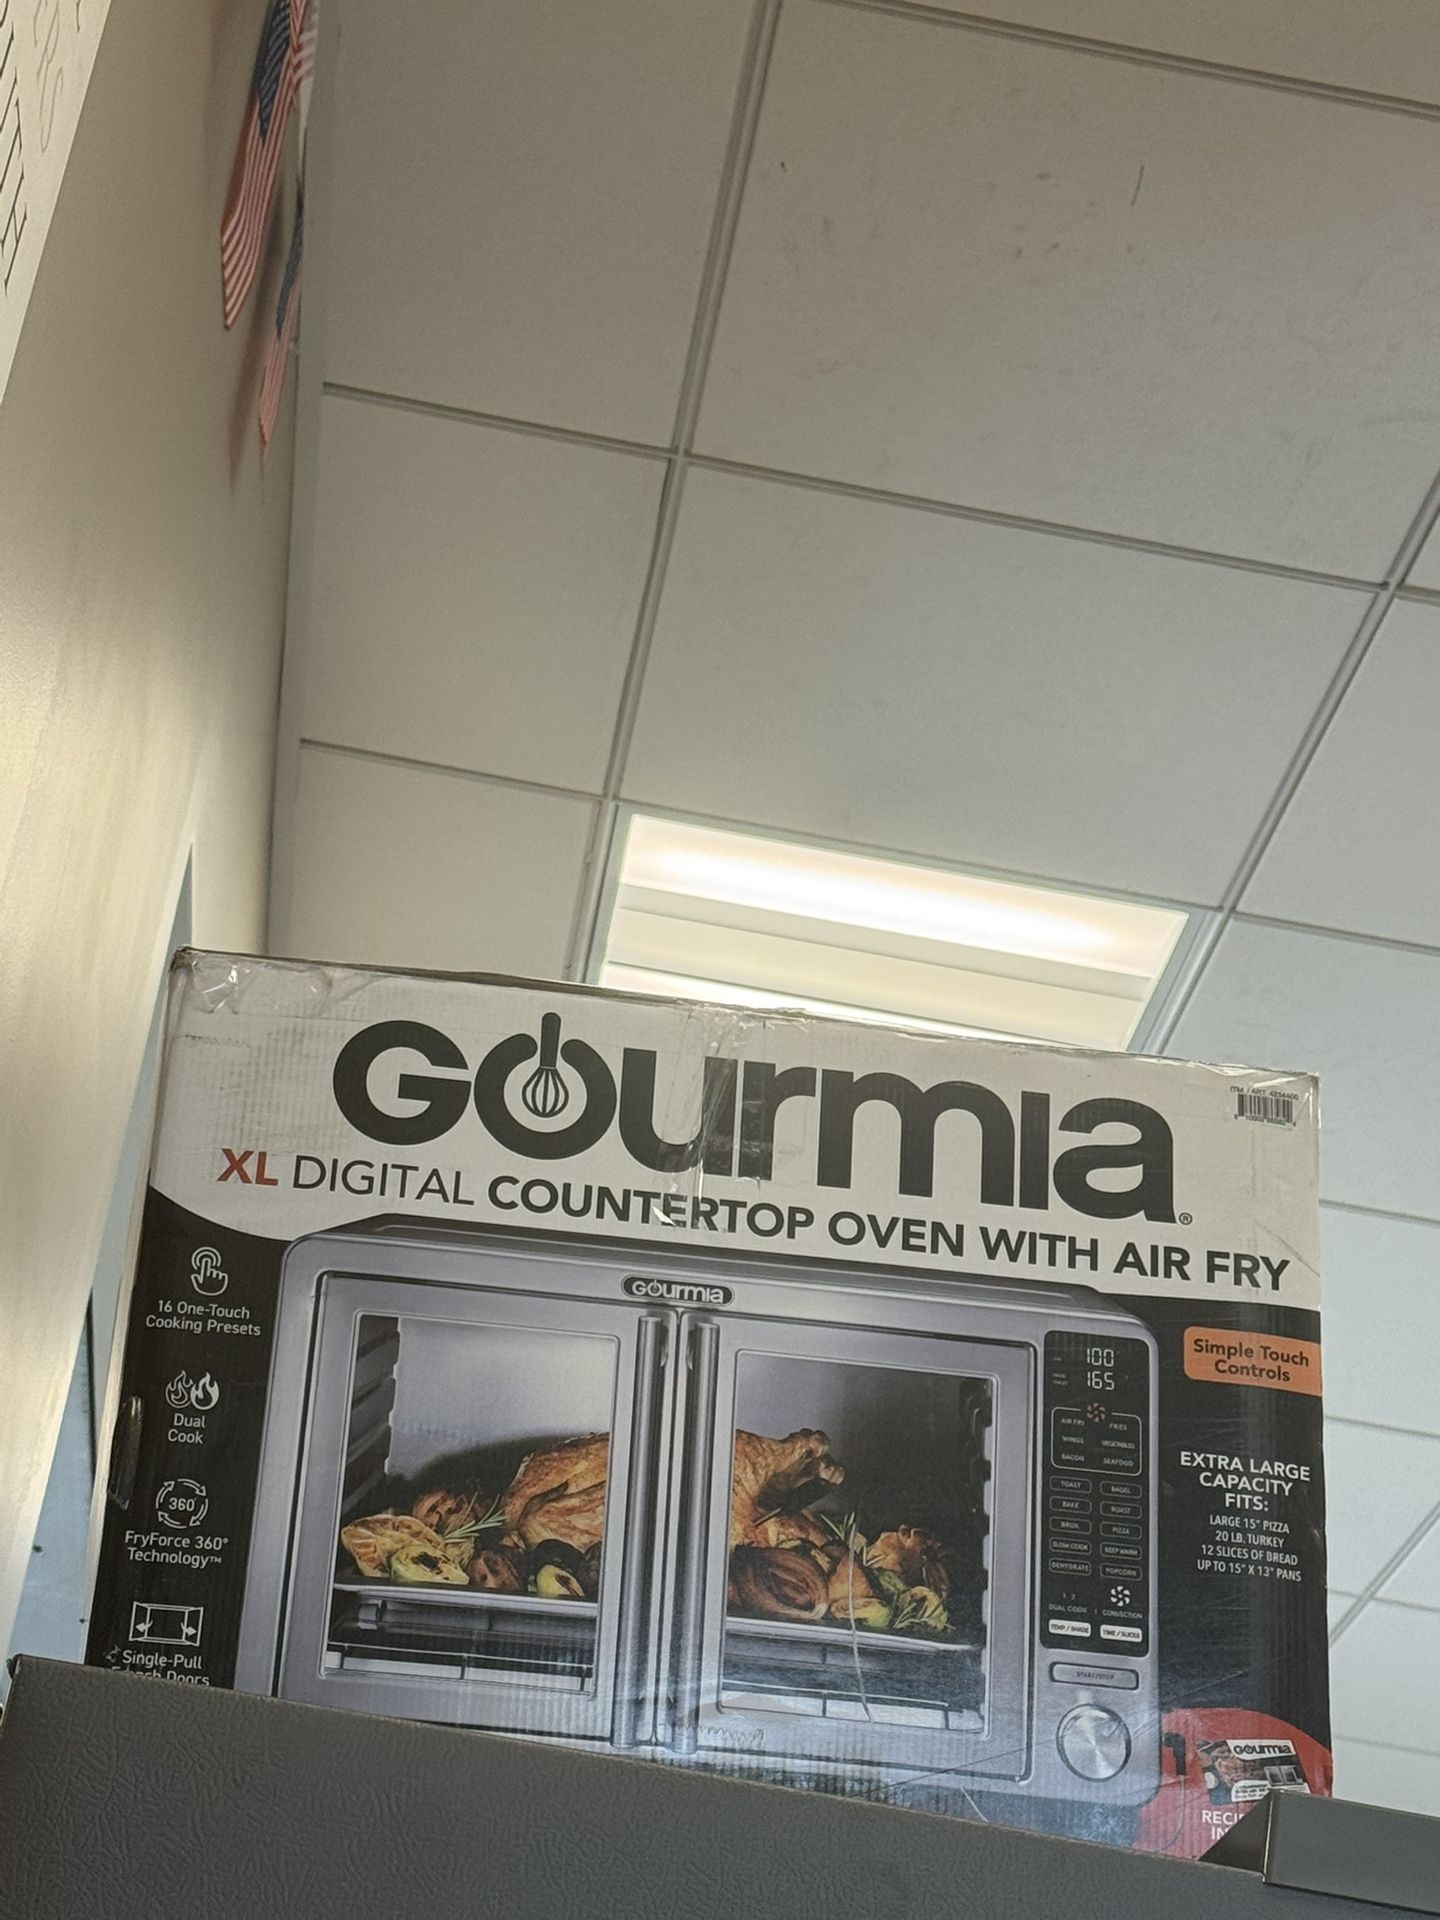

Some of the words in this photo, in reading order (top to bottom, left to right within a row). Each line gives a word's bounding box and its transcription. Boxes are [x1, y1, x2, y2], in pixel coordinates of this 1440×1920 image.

[216, 1147, 279, 1187] XL
[292, 1155, 474, 1207] DIGITAL
[487, 1174, 815, 1241] COUNTERTOP
[827, 1210, 965, 1259] OVEN
[980, 1227, 1099, 1273] WITH
[1113, 1241, 1191, 1281] AIR
[1205, 1251, 1290, 1291] FRY
[631, 1279, 724, 1304] Gourmia
[158, 1300, 173, 1314] 16
[177, 1301, 250, 1320] One-Touch
[146, 1315, 202, 1334] Cooking
[206, 1319, 261, 1336] Presets
[1087, 1348, 1114, 1367] 100
[1193, 1338, 1254, 1358] Simple
[1259, 1345, 1309, 1367] Touch
[1214, 1359, 1291, 1382] Controls
[1087, 1371, 1115, 1390] 165
[173, 1413, 206, 1429] Dual
[167, 1429, 204, 1444] Cook
[1061, 1453, 1085, 1462] BACON
[1103, 1458, 1134, 1467] SEAFOOD
[1180, 1451, 1244, 1472] EXTRA
[1249, 1458, 1311, 1481] LARGE
[1060, 1480, 1081, 1488] TOAST
[1111, 1485, 1131, 1494] BAGEL
[1199, 1472, 1293, 1496] CAPACITY
[1062, 1501, 1080, 1509] BAKE
[1111, 1506, 1131, 1514] ROAST
[1225, 1492, 1269, 1511] FITS:
[1112, 1526, 1130, 1535] PIZZA
[1209, 1514, 1241, 1528] LARGE
[1262, 1520, 1290, 1534] PIZZA
[125, 1530, 191, 1549] FryForce
[194, 1535, 229, 1551] 360°
[1071, 1543, 1088, 1551] COOK
[1215, 1530, 1229, 1542] 20
[1231, 1531, 1246, 1544] LB.
[1247, 1533, 1284, 1549] TURKEY
[1201, 1544, 1214, 1556] 12
[1216, 1545, 1249, 1559] SLICES
[1250, 1549, 1264, 1560] OF
[1266, 1551, 1298, 1566] BREAD
[1051, 1561, 1089, 1572] DEHYDRATE
[1105, 1567, 1137, 1577] POPCORN
[1197, 1559, 1212, 1571] UP
[1213, 1560, 1226, 1572] TO
[1248, 1564, 1255, 1576] X
[1276, 1568, 1302, 1582] PANS
[1049, 1603, 1066, 1612] DUAL
[122, 1650, 203, 1670] Single-Pull
